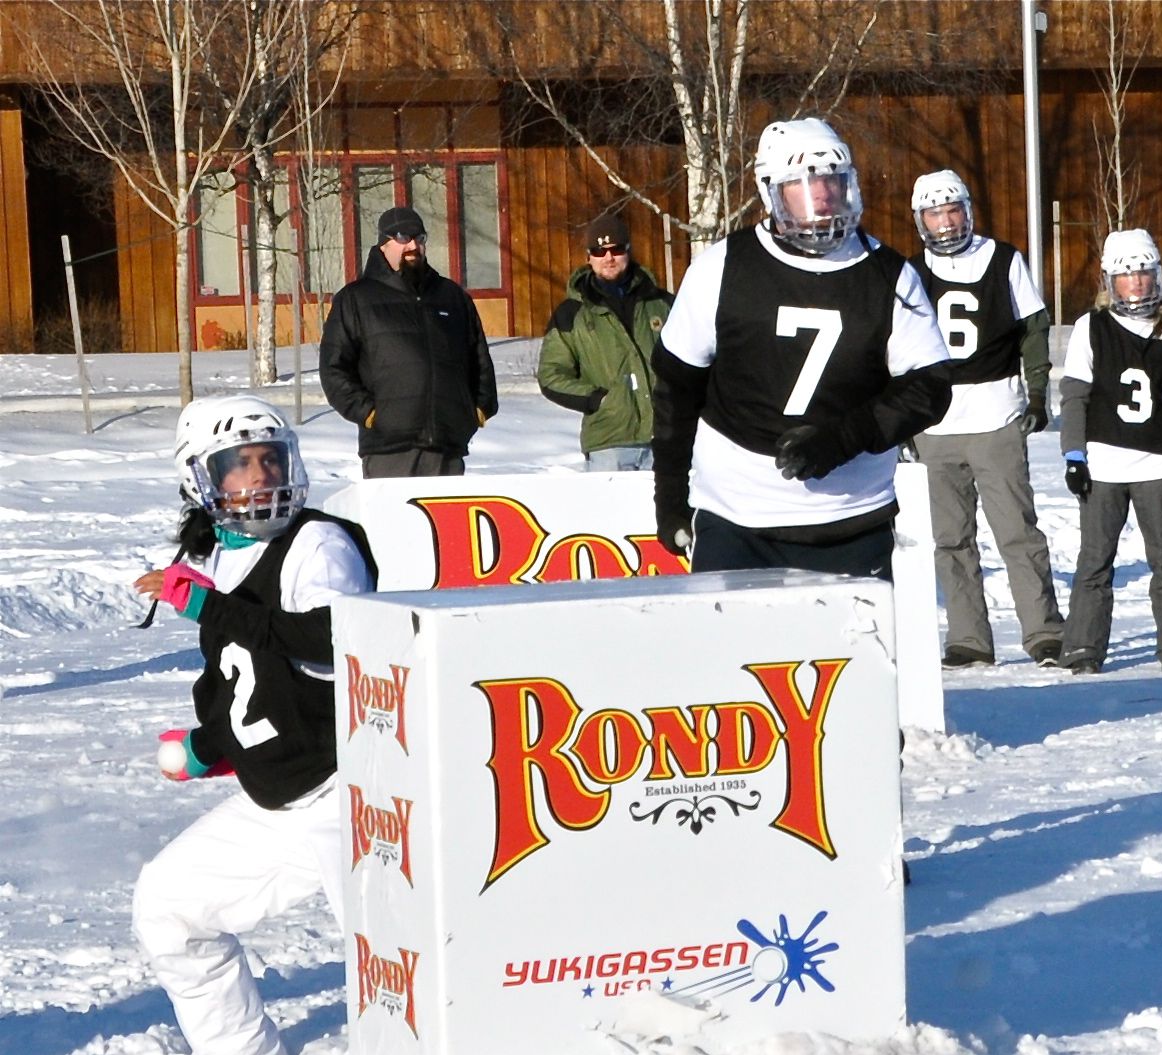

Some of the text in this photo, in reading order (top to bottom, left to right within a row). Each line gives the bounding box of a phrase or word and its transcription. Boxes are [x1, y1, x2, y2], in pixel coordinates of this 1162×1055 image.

[937, 290, 979, 360] 6
[776, 305, 843, 415] 7
[1117, 367, 1153, 423] 3
[219, 641, 279, 750] 2
[645, 779, 747, 797] Established 1935
[502, 941, 749, 987] YUKIGASSEN
